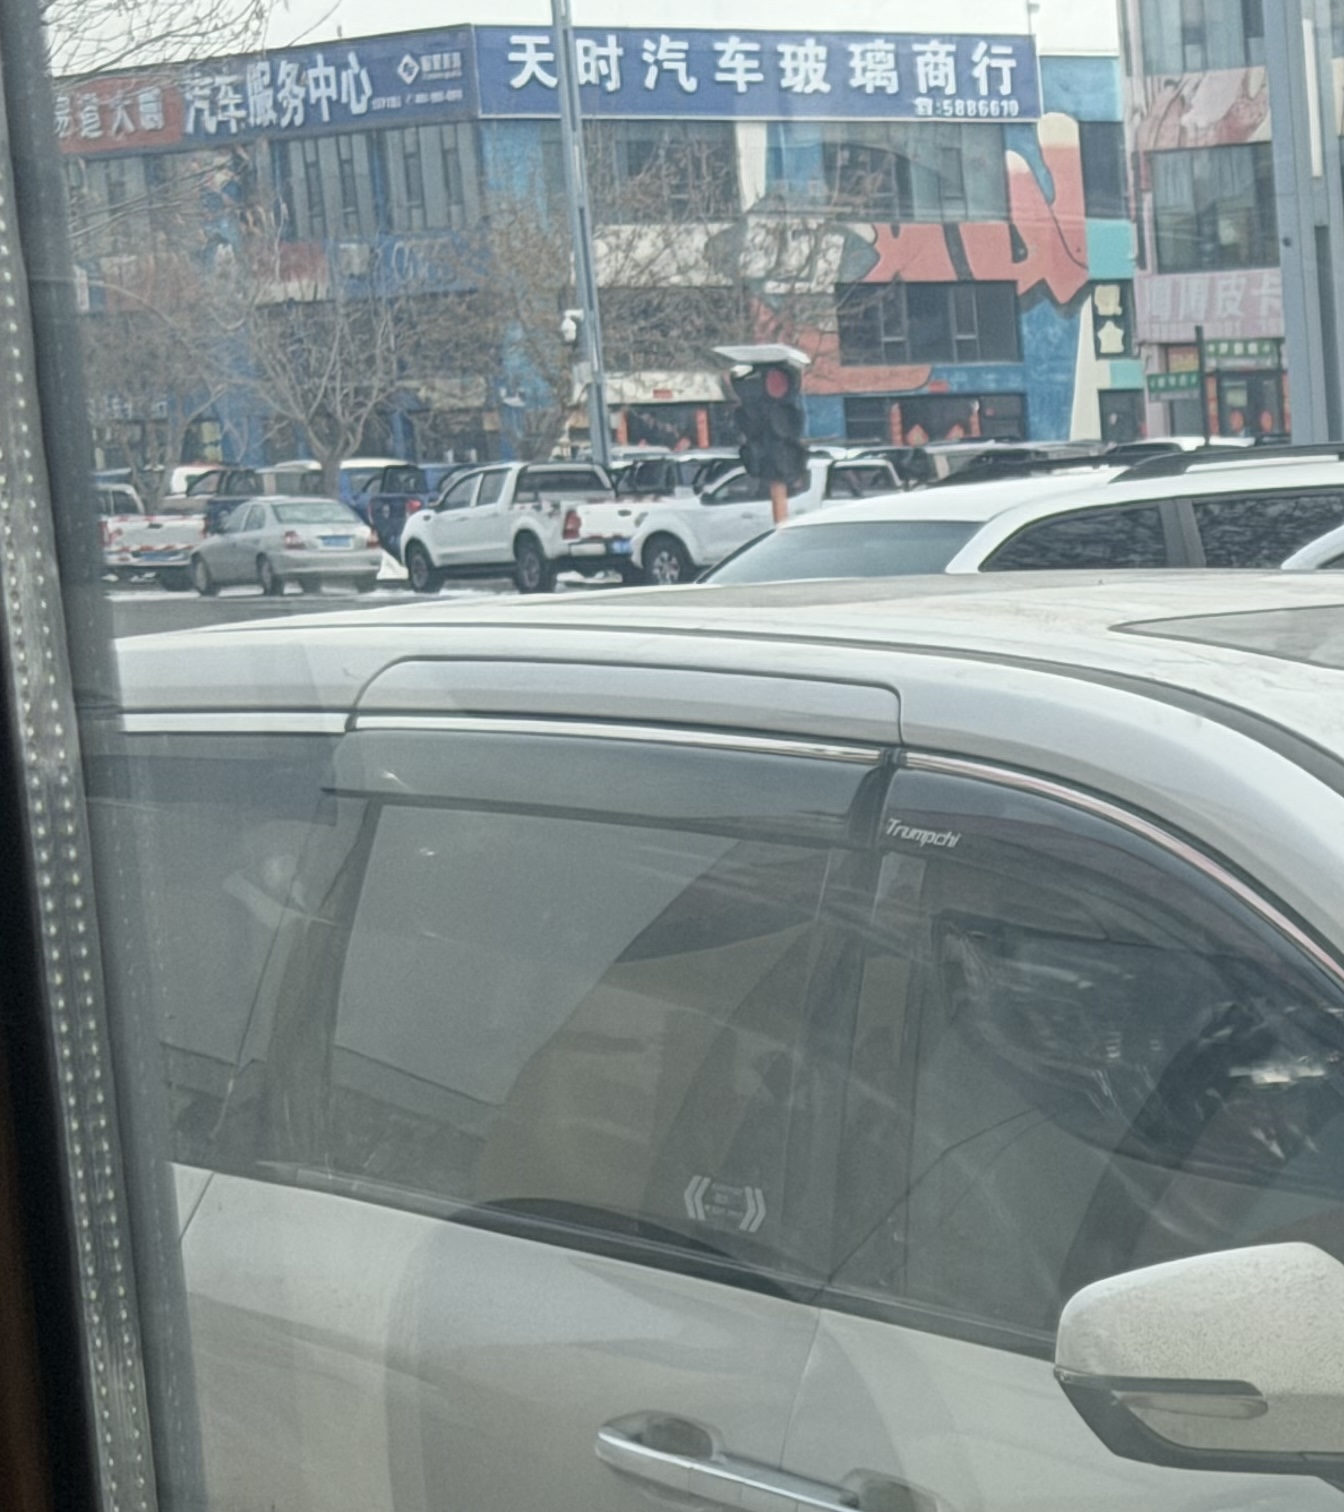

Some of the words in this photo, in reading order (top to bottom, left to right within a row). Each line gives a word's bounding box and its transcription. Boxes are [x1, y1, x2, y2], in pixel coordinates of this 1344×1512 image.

[184, 51, 373, 134] 汽车服务中心
[508, 34, 1017, 95] 天时汽车玻璃商行
[886, 817, 962, 848] Trumpchi
